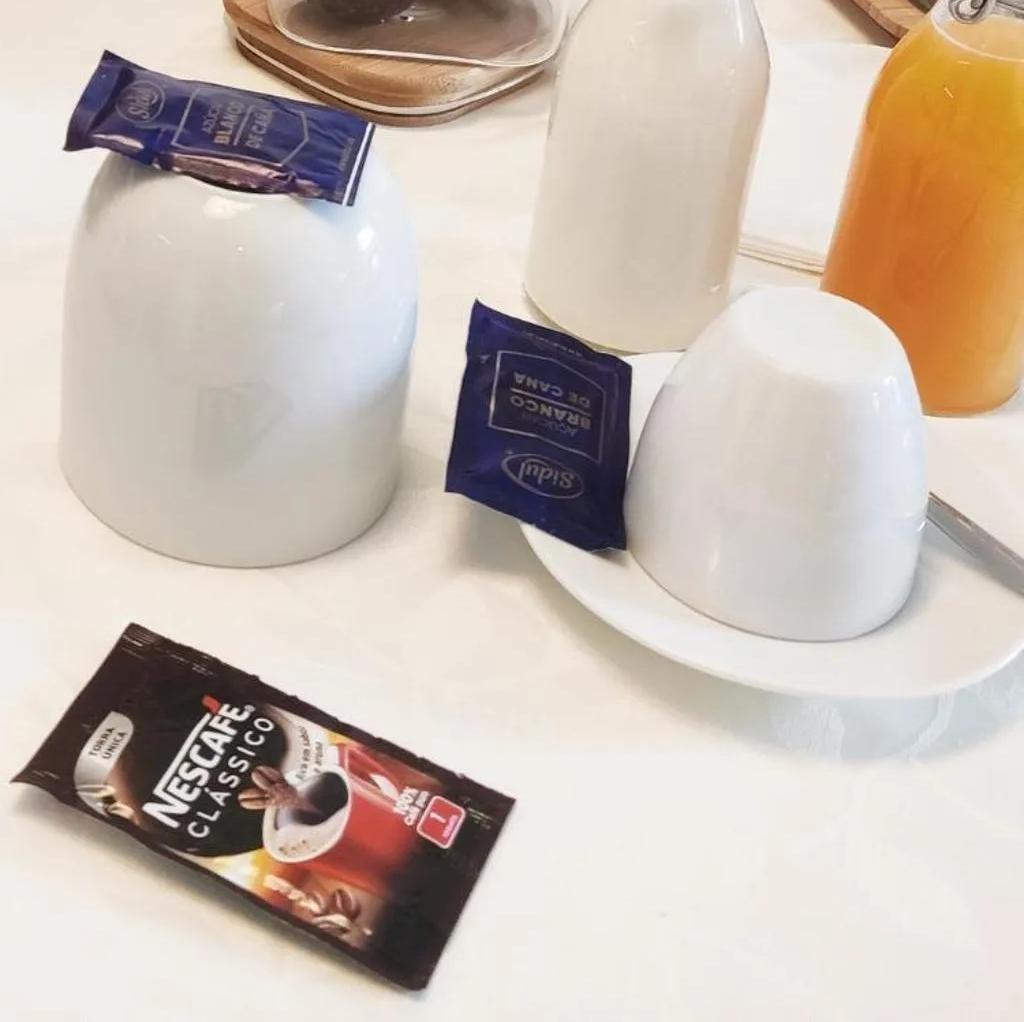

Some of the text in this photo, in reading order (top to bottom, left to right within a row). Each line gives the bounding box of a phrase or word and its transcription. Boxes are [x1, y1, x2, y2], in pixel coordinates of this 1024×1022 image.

[213, 100, 245, 145] BLANCO
[513, 371, 564, 397] CANA
[511, 396, 591, 430] BRANCO
[518, 459, 575, 488] Sidul
[187, 718, 275, 838] CLÁSSICO
